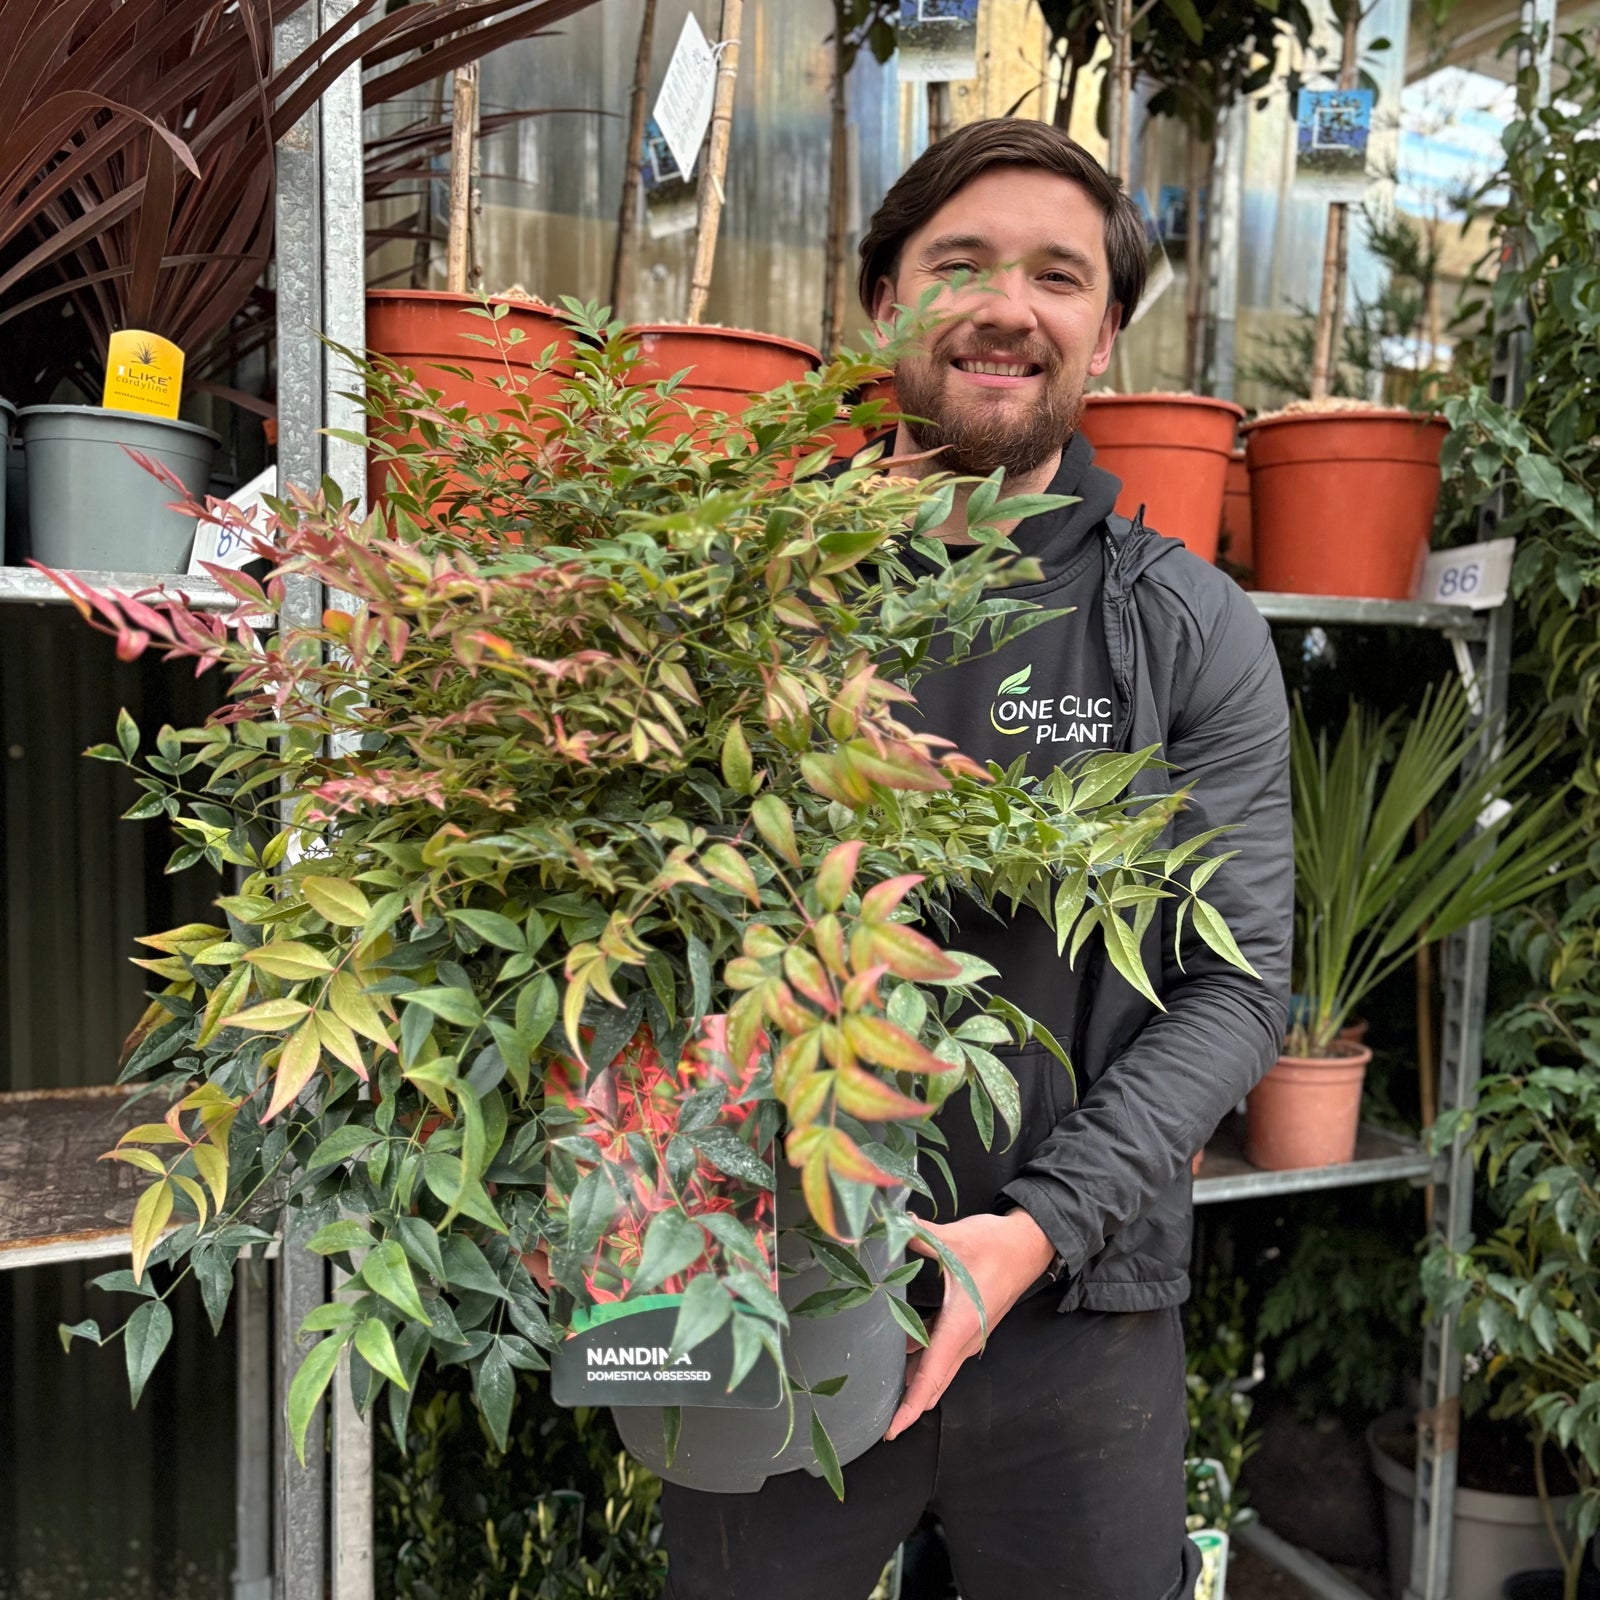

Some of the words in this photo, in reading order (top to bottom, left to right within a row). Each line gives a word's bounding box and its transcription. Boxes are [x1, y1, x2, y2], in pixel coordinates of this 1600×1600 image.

[115, 376, 169, 393] cordyline
[128, 368, 169, 387] LIKE
[1440, 563, 1479, 597] 86
[999, 699, 1054, 721] ONE
[1059, 695, 1111, 718] CLIC
[1036, 722, 1113, 744] PLANT
[587, 1347, 692, 1366] NANDINA
[587, 1371, 651, 1381] DOMESTICA
[653, 1371, 711, 1381] OBSESSED
